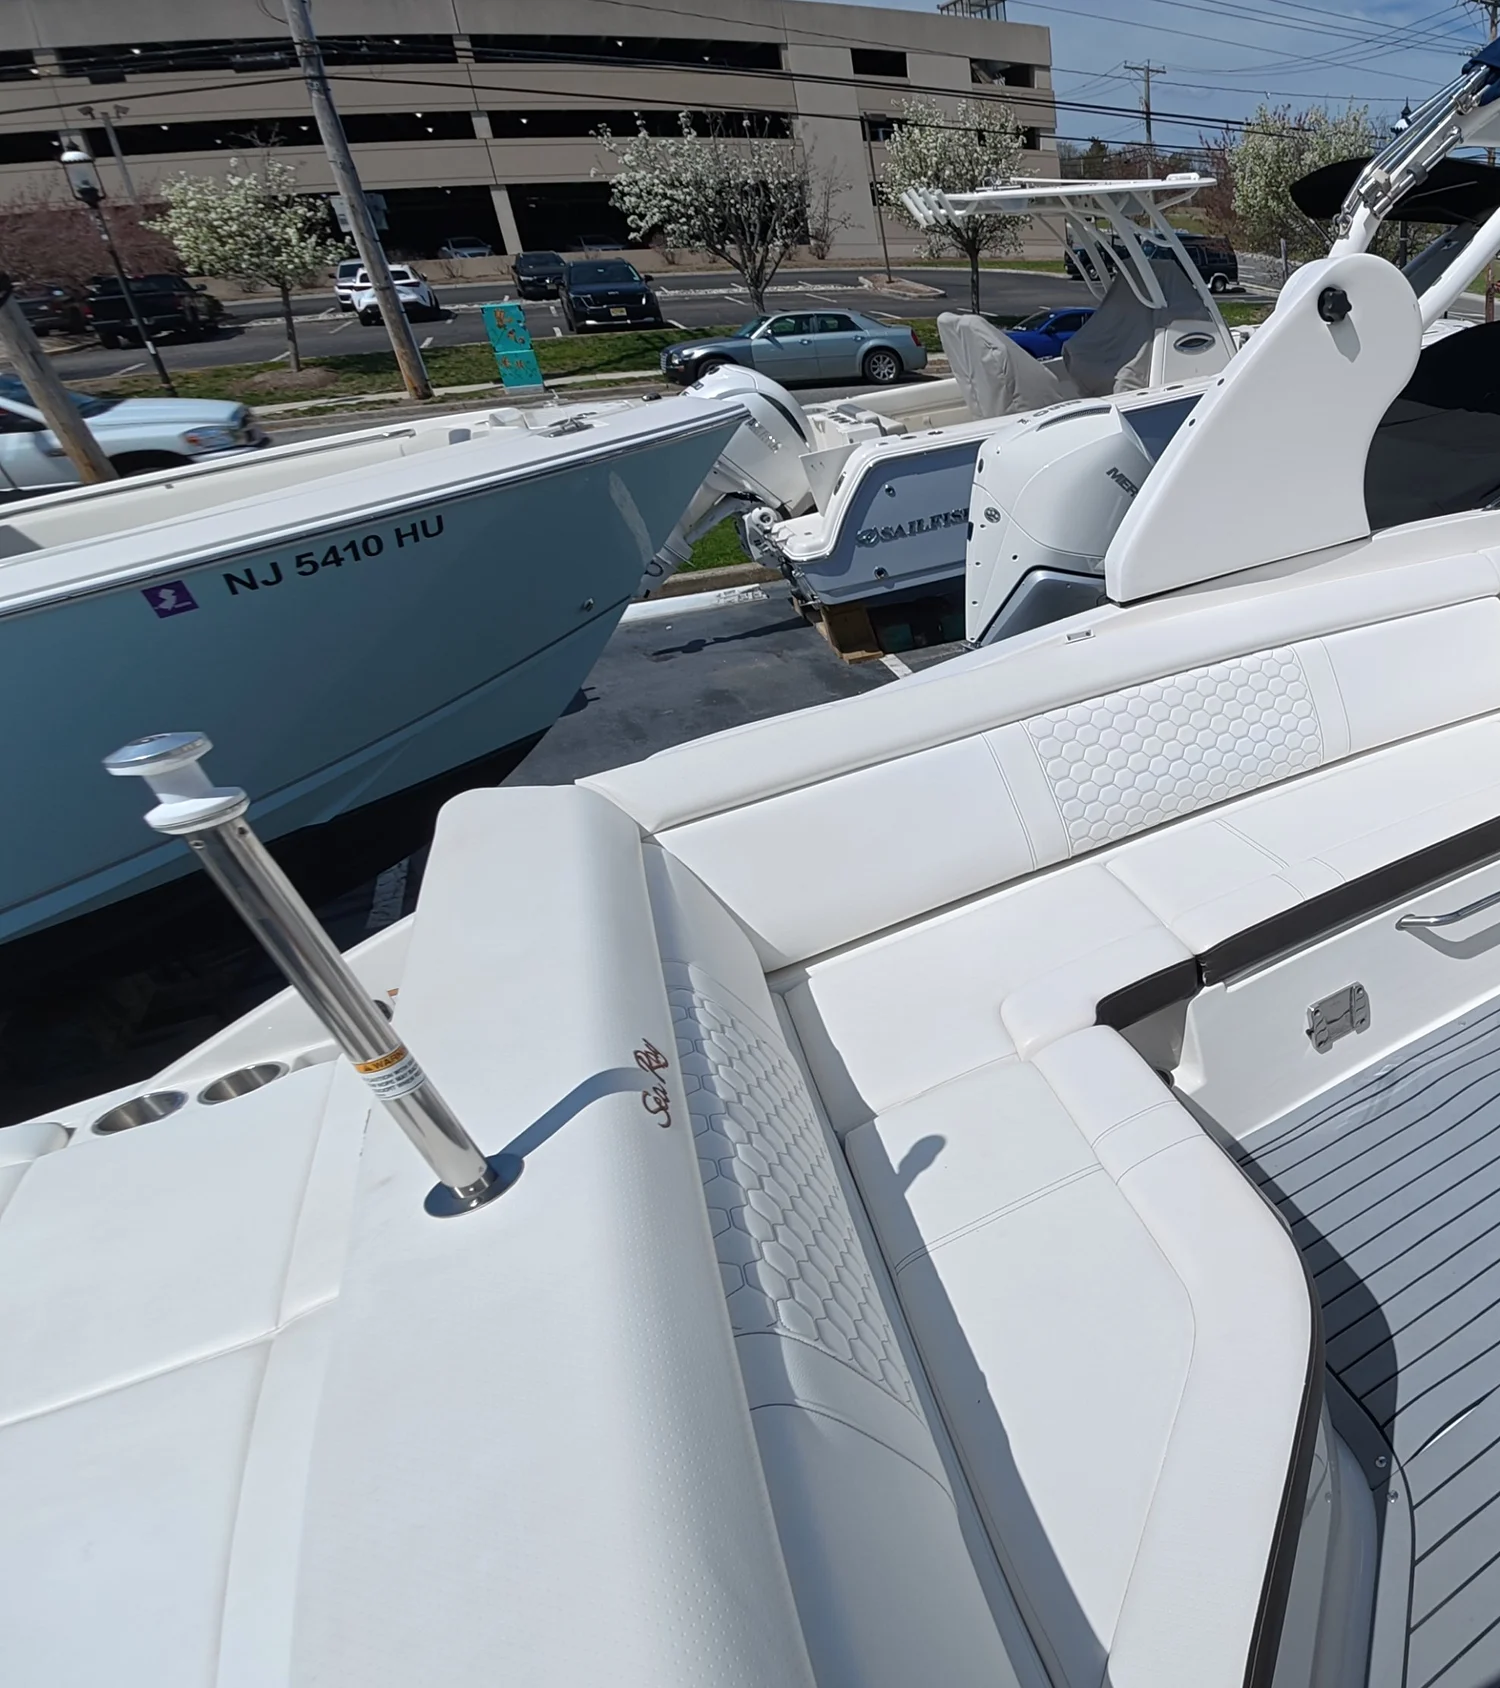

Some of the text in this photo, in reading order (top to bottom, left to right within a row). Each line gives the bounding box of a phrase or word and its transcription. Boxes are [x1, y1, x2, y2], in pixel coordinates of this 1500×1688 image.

[222, 514, 445, 596] NJ 5410 HU
